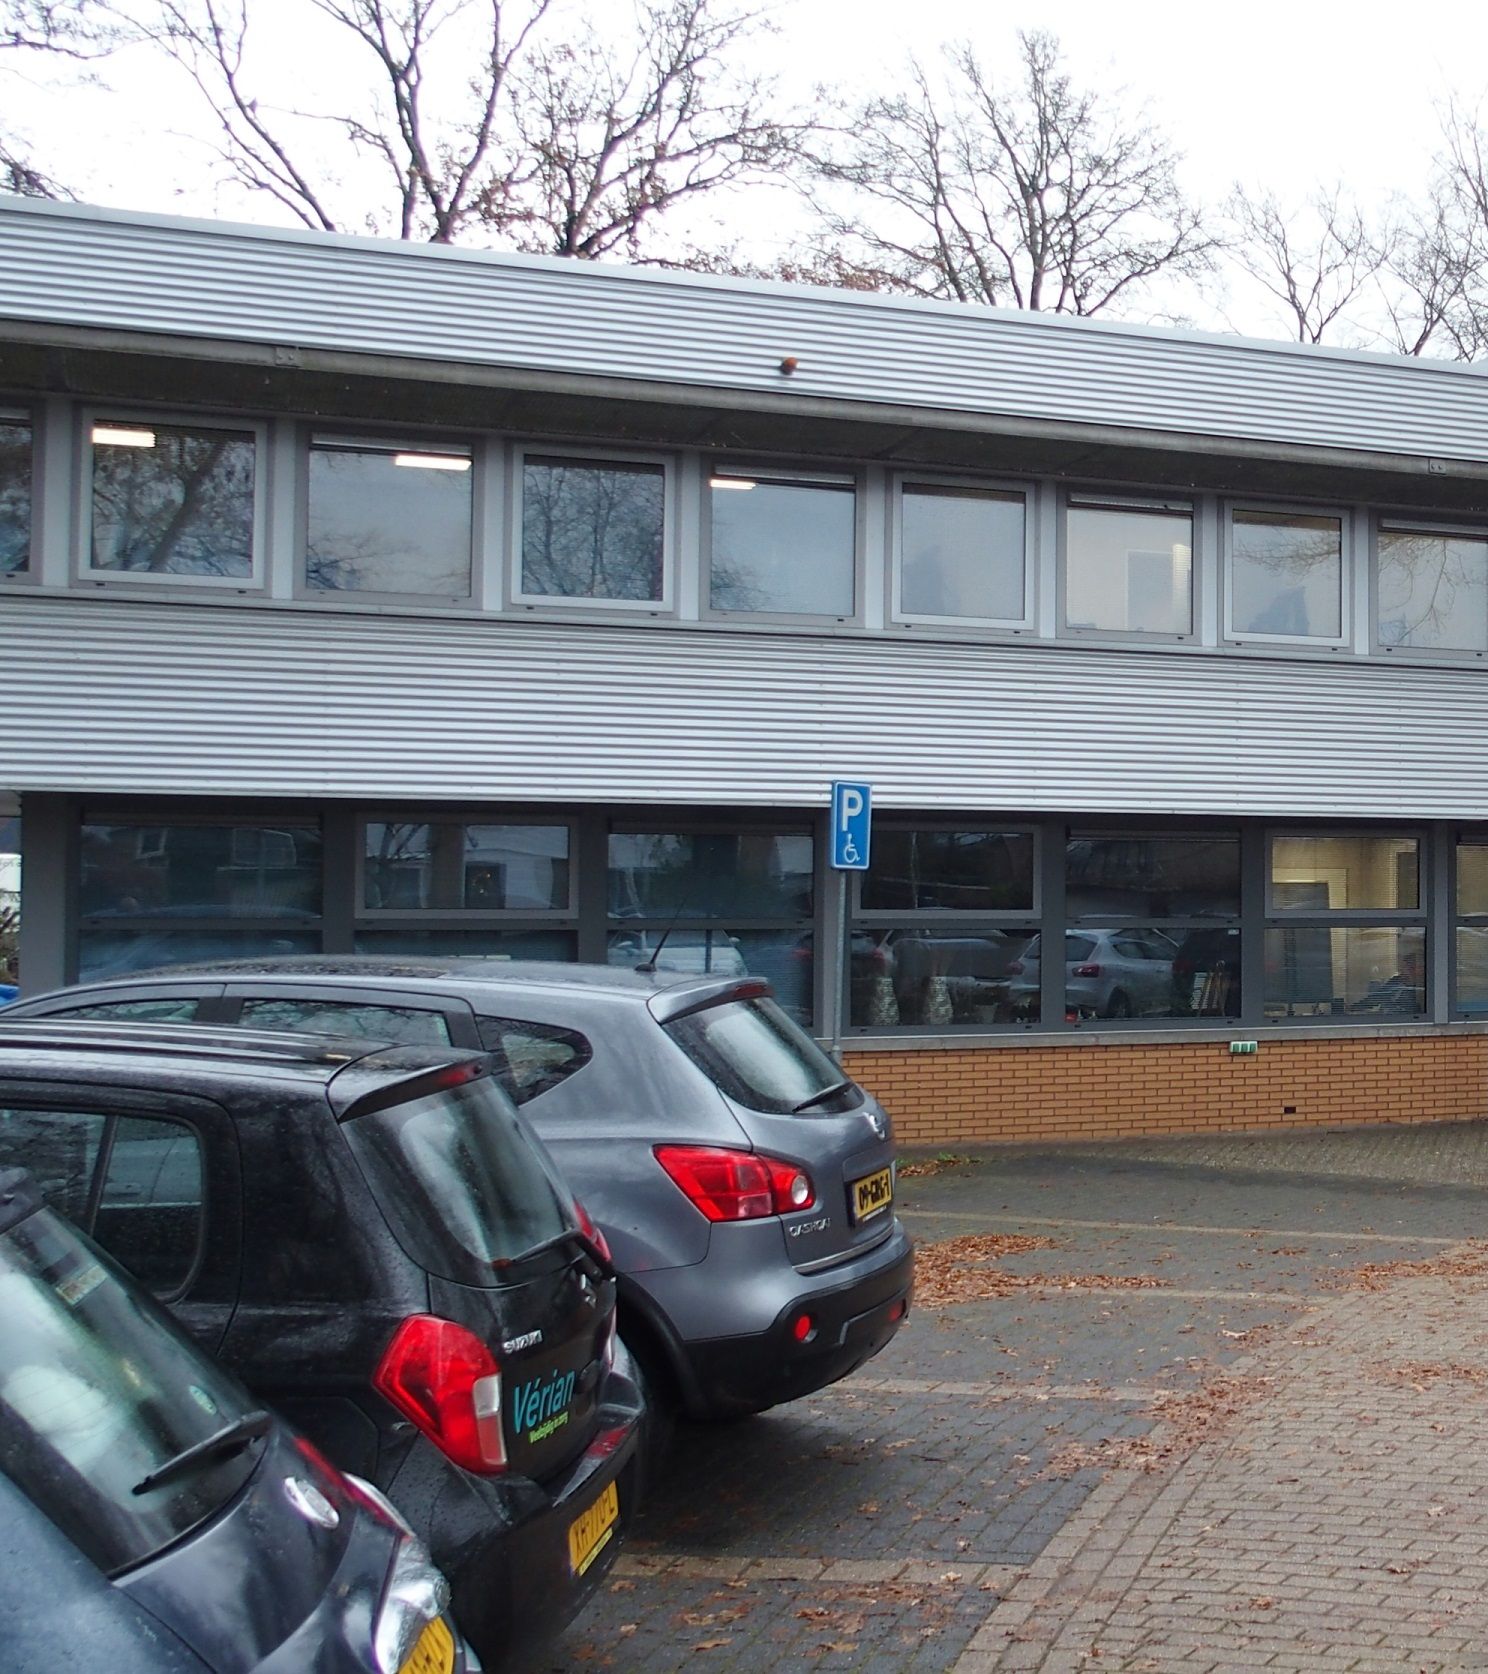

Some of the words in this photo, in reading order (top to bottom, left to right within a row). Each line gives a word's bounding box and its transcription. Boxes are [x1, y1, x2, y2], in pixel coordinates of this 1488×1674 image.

[842, 789, 863, 832] P
[502, 1330, 543, 1354] SUZUKI
[513, 1369, 575, 1433] Vérian
